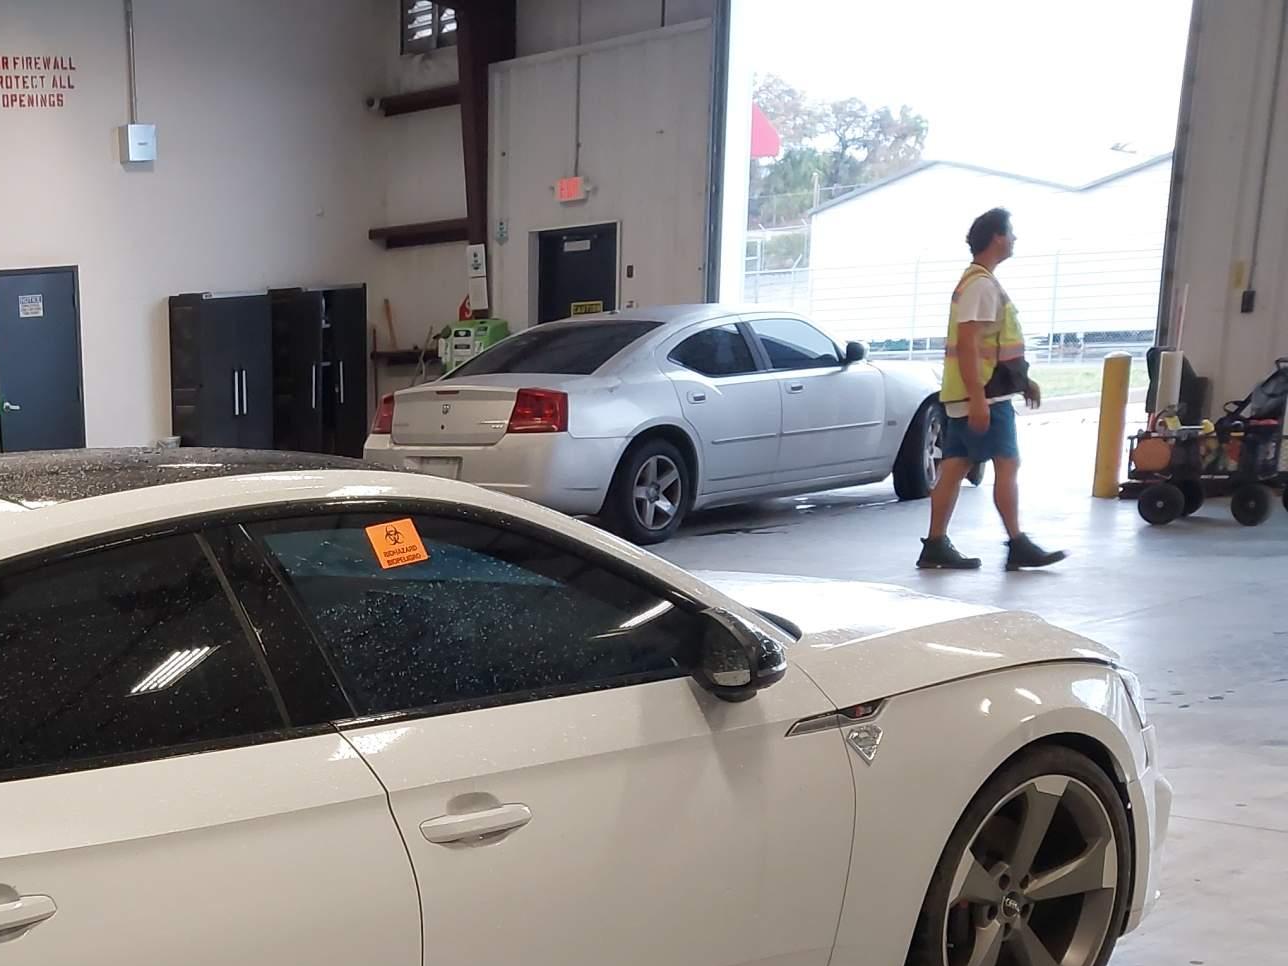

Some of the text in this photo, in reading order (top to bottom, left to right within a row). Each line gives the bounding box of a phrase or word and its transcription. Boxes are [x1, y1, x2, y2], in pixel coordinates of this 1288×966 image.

[13, 56, 76, 70] FIREWALL
[52, 75, 75, 89] ALL
[1, 93, 64, 108] OPENINGS
